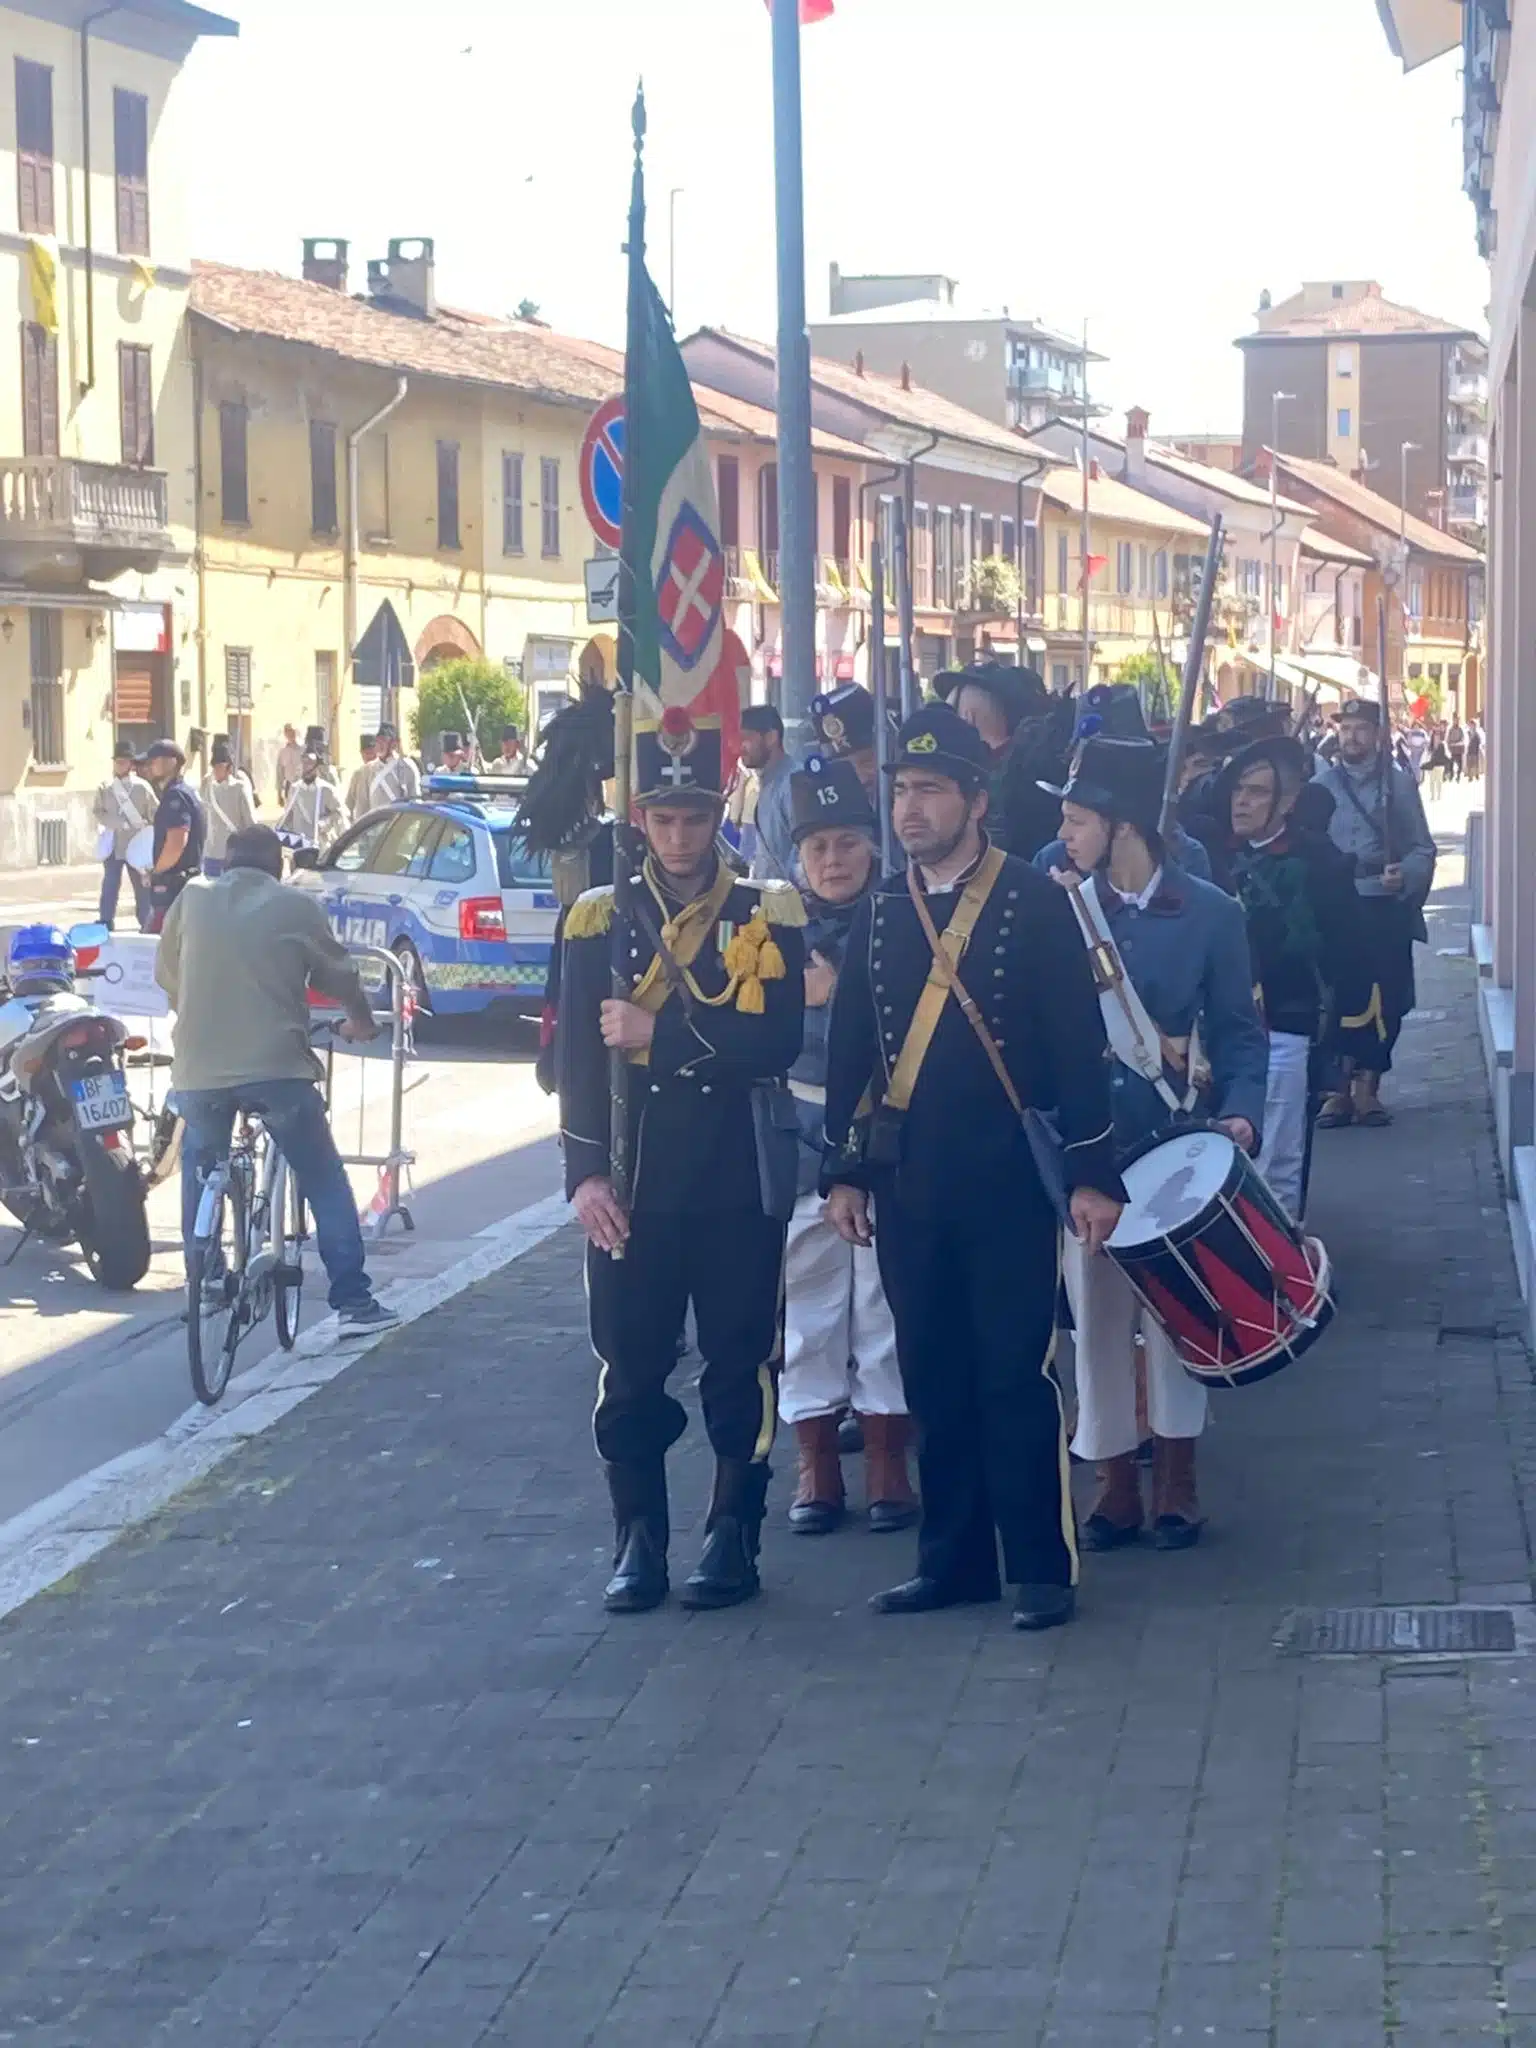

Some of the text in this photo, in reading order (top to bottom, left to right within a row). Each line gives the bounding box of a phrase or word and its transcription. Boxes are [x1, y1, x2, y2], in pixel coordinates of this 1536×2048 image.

[816, 785, 840, 806] 13
[328, 914, 387, 948] LIZIA
[82, 1097, 127, 1124] 16407
